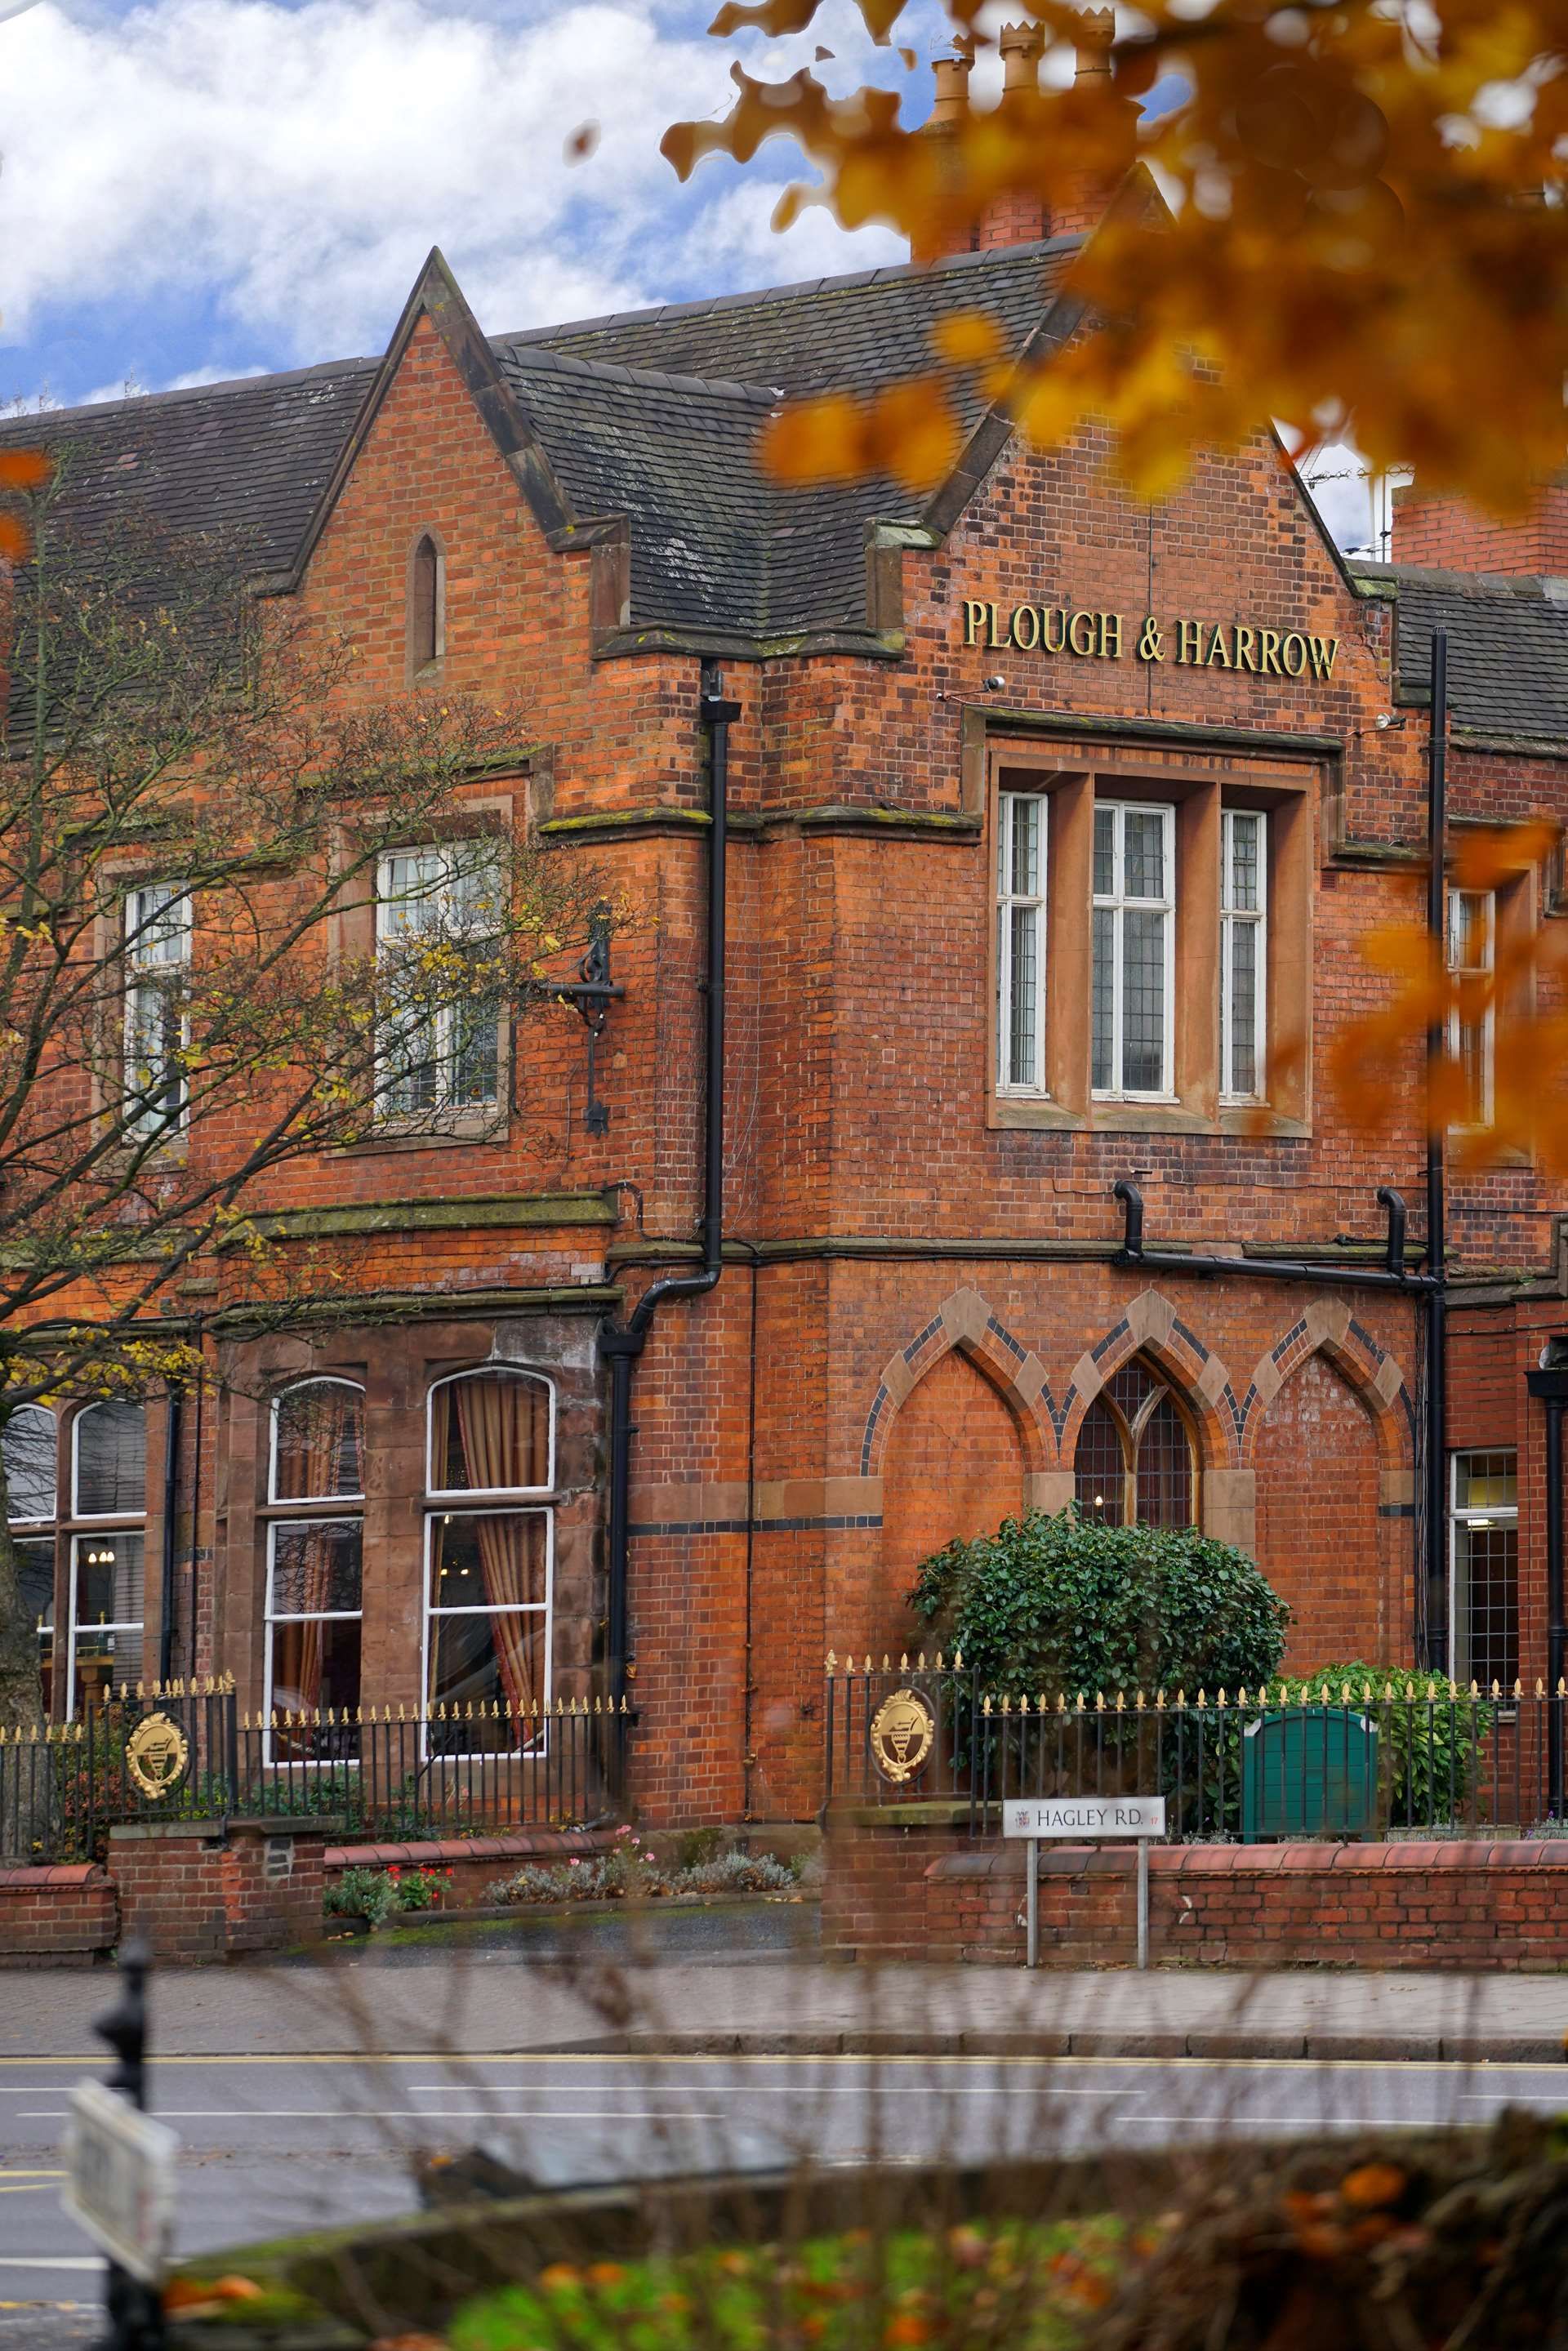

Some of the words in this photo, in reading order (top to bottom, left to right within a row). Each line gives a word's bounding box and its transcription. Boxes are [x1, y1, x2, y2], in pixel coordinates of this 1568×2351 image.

[962, 600, 1125, 658] PLOUGH
[1139, 615, 1165, 661] &
[1176, 620, 1341, 680] HARROW
[1037, 1808, 1107, 1827] HAGLEY
[1115, 1808, 1144, 1826] RD.
[1150, 1816, 1158, 1826] 17
